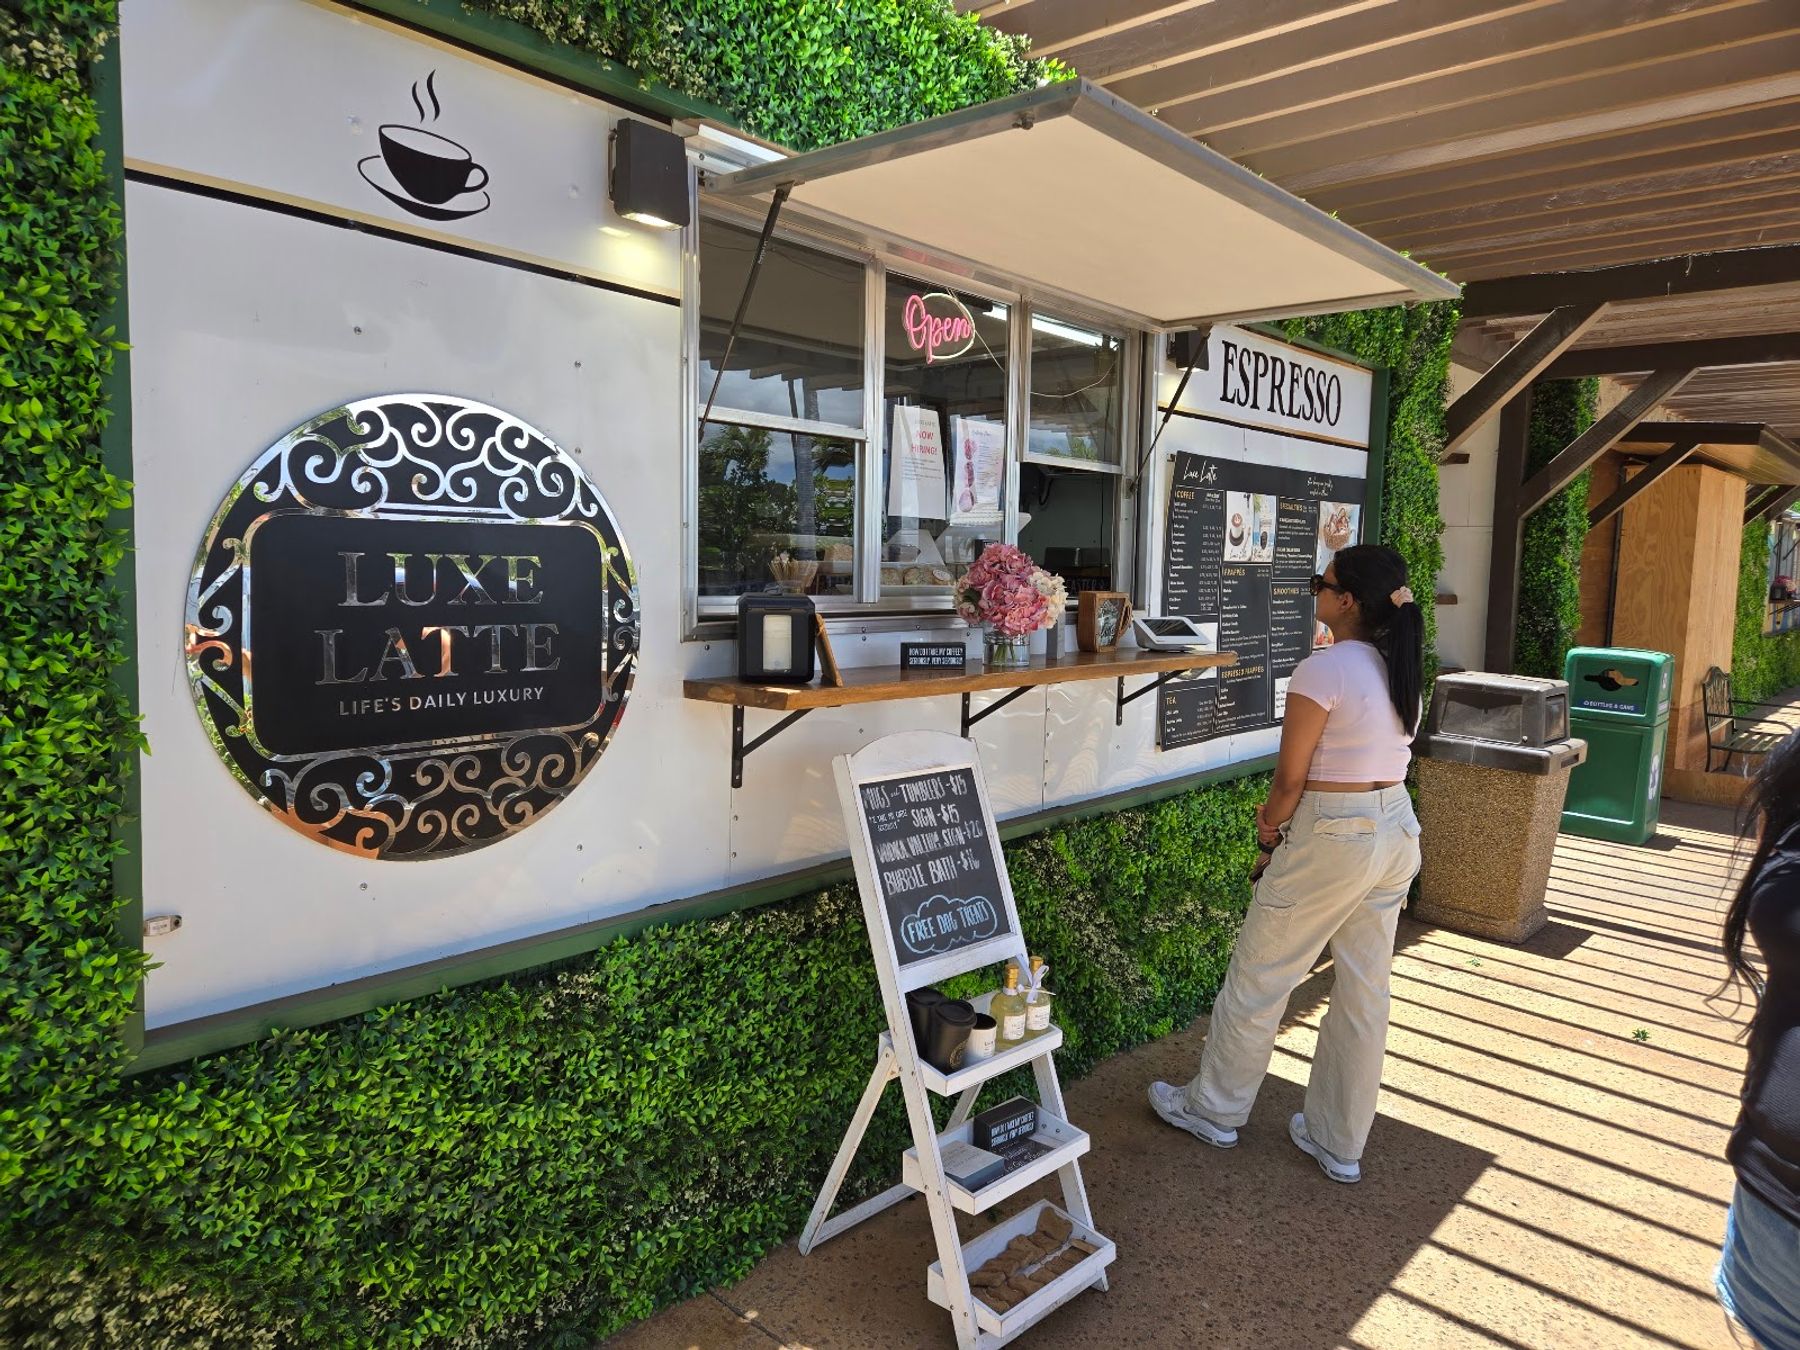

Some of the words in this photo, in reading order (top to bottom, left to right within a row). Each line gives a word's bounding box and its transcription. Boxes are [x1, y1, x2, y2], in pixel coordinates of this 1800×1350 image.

[904, 294, 971, 365] Open
[1219, 340, 1341, 426] ESPRESSO
[911, 443, 938, 455] HIRING!
[916, 430, 934, 440] NOW
[337, 552, 544, 607] LUXE
[313, 623, 561, 685] LATTE
[338, 698, 401, 716] LIFE'S
[409, 692, 467, 710] DAILY
[473, 687, 544, 705] LUXURY
[898, 776, 946, 804] TUMBLERS
[911, 807, 938, 828] SIGN
[941, 826, 966, 848] SIGN
[883, 864, 928, 897] BUBBLE
[928, 855, 959, 885] BATH
[907, 917, 937, 943] FREE
[936, 911, 958, 935] DOG
[956, 901, 989, 928] TREATS
